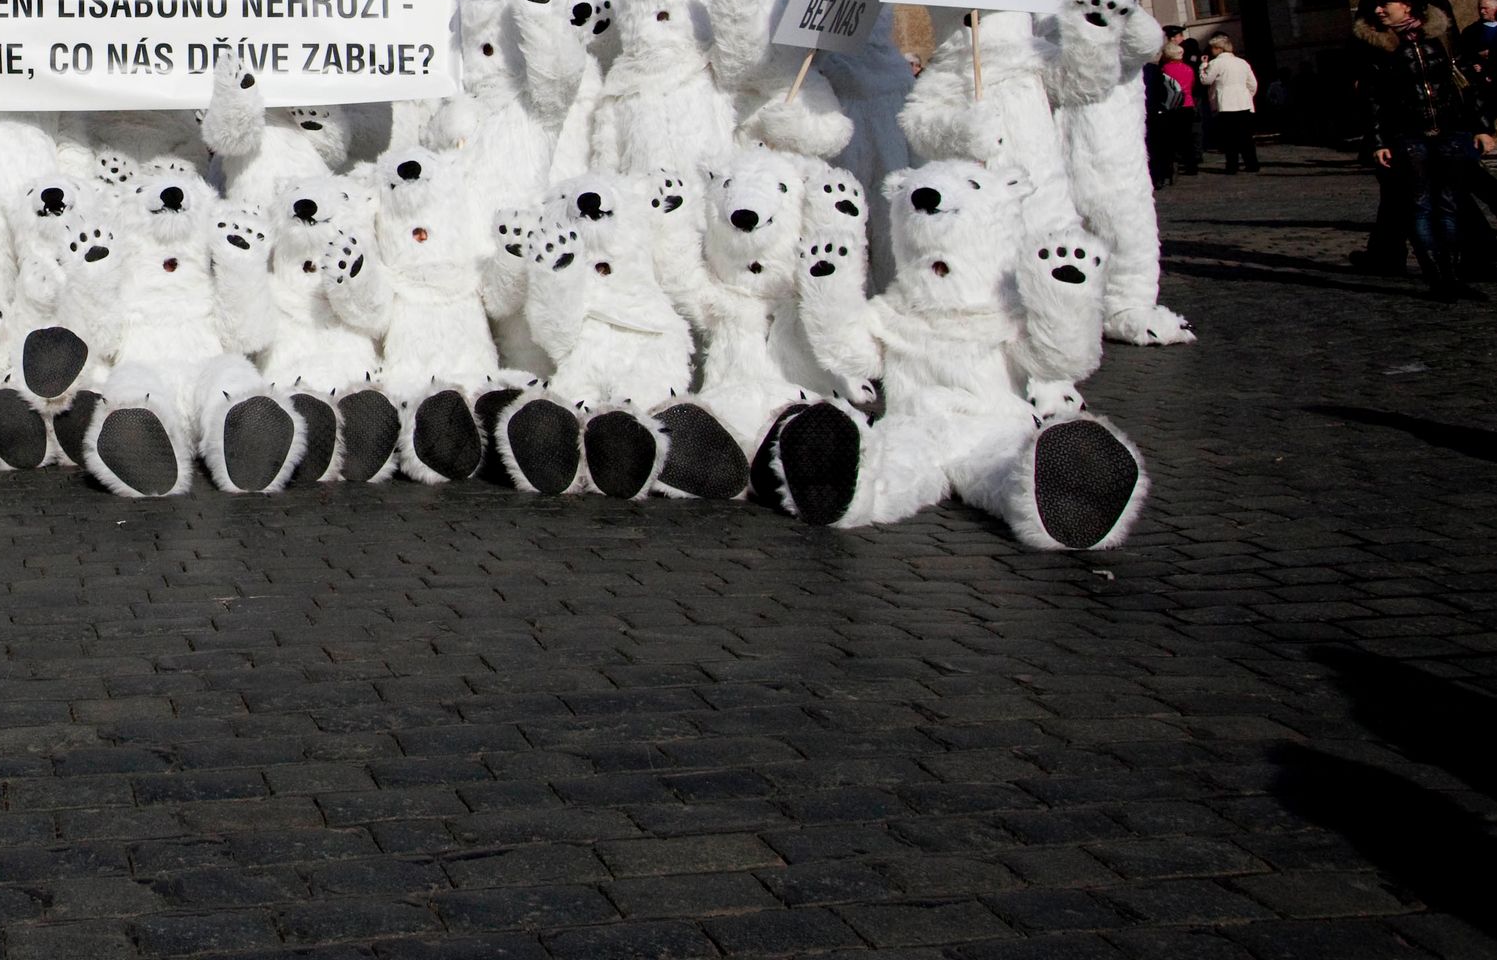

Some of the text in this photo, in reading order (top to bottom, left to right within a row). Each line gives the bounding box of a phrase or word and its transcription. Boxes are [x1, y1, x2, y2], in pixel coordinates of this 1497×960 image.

[49, 42, 94, 75] CO
[107, 36, 174, 75] NÁS
[301, 42, 435, 76] ZABIJE?
